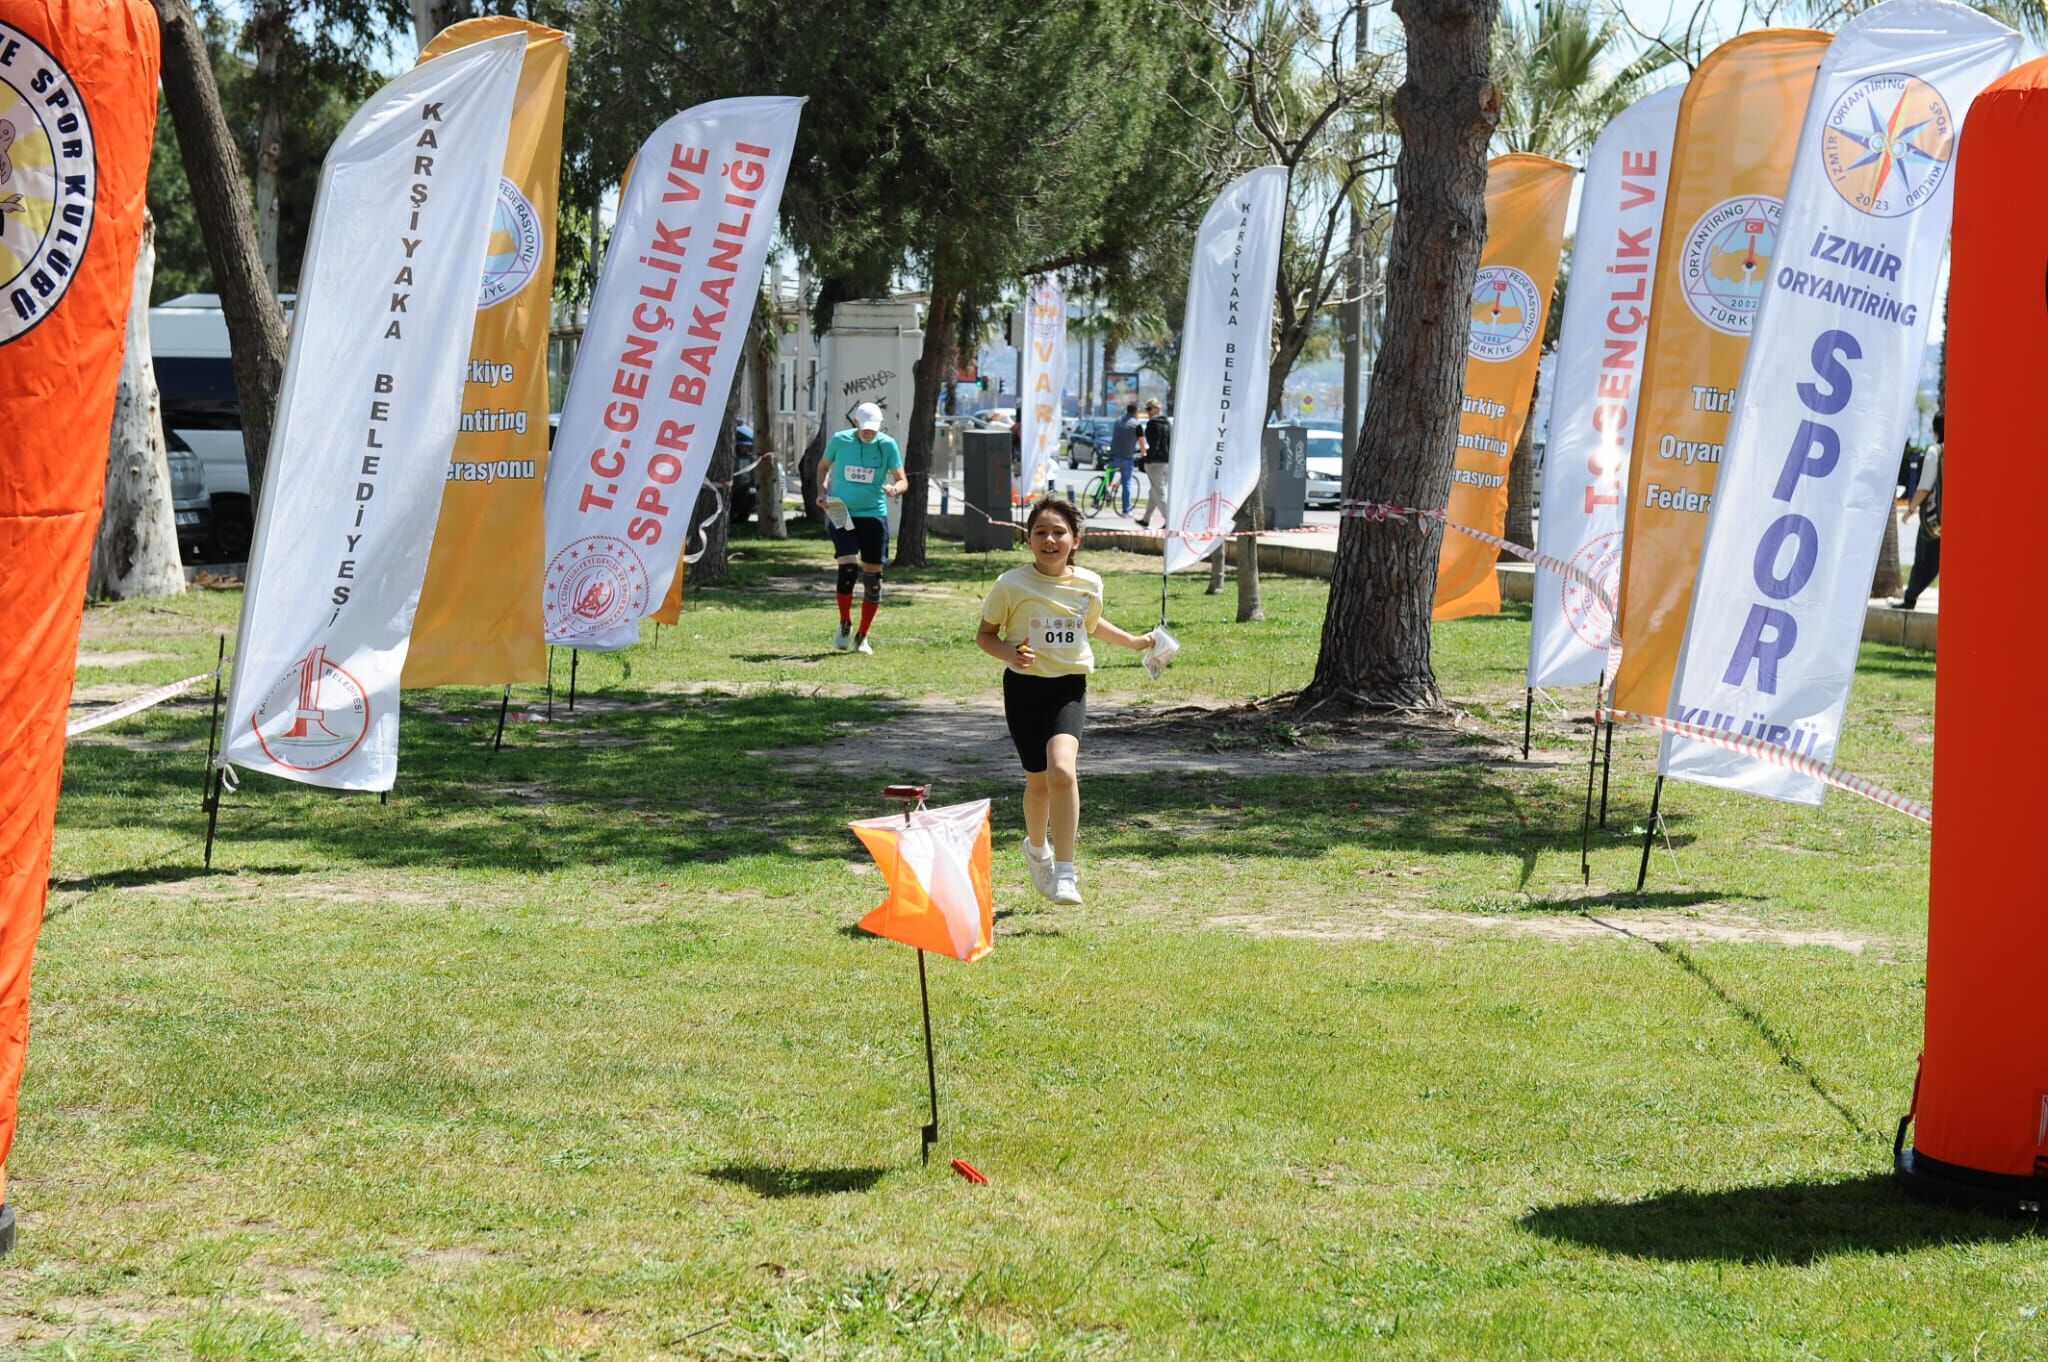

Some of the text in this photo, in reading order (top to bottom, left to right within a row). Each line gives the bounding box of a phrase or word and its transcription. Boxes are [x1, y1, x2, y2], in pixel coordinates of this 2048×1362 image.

[1929, 101, 1947, 135] SPOR
[0, 33, 86, 321] E SPOR KULÜBÜ
[1619, 149, 1658, 211] VE
[1689, 203, 1744, 278] ORYANTİRİNG
[1810, 225, 1902, 282] İZMİR
[1228, 202, 1252, 326] KARŞIYAKA
[1731, 299, 1758, 309] 2002
[1777, 266, 1918, 327] ORYANTİRİNG
[578, 218, 692, 514] T.C.GENÇLİK
[662, 142, 710, 203] VE
[627, 141, 771, 546] SPOR BAKANLIĞI
[1469, 340, 1513, 355] ÜRKİYE
[328, 102, 444, 628] KARŞIYAKA BELEDİYESİ
[463, 359, 514, 389] rkiye
[458, 407, 528, 435] ntiring
[1214, 343, 1236, 480] BELEDİYESİ
[1461, 395, 1506, 420] ürkiye
[1456, 433, 1509, 457] antiring
[1659, 433, 1723, 466] Oryan
[446, 460, 536, 485] erasyonu
[1645, 482, 1713, 513] Feder
[1721, 329, 1863, 696] SPOR
[1045, 631, 1074, 643] 018
